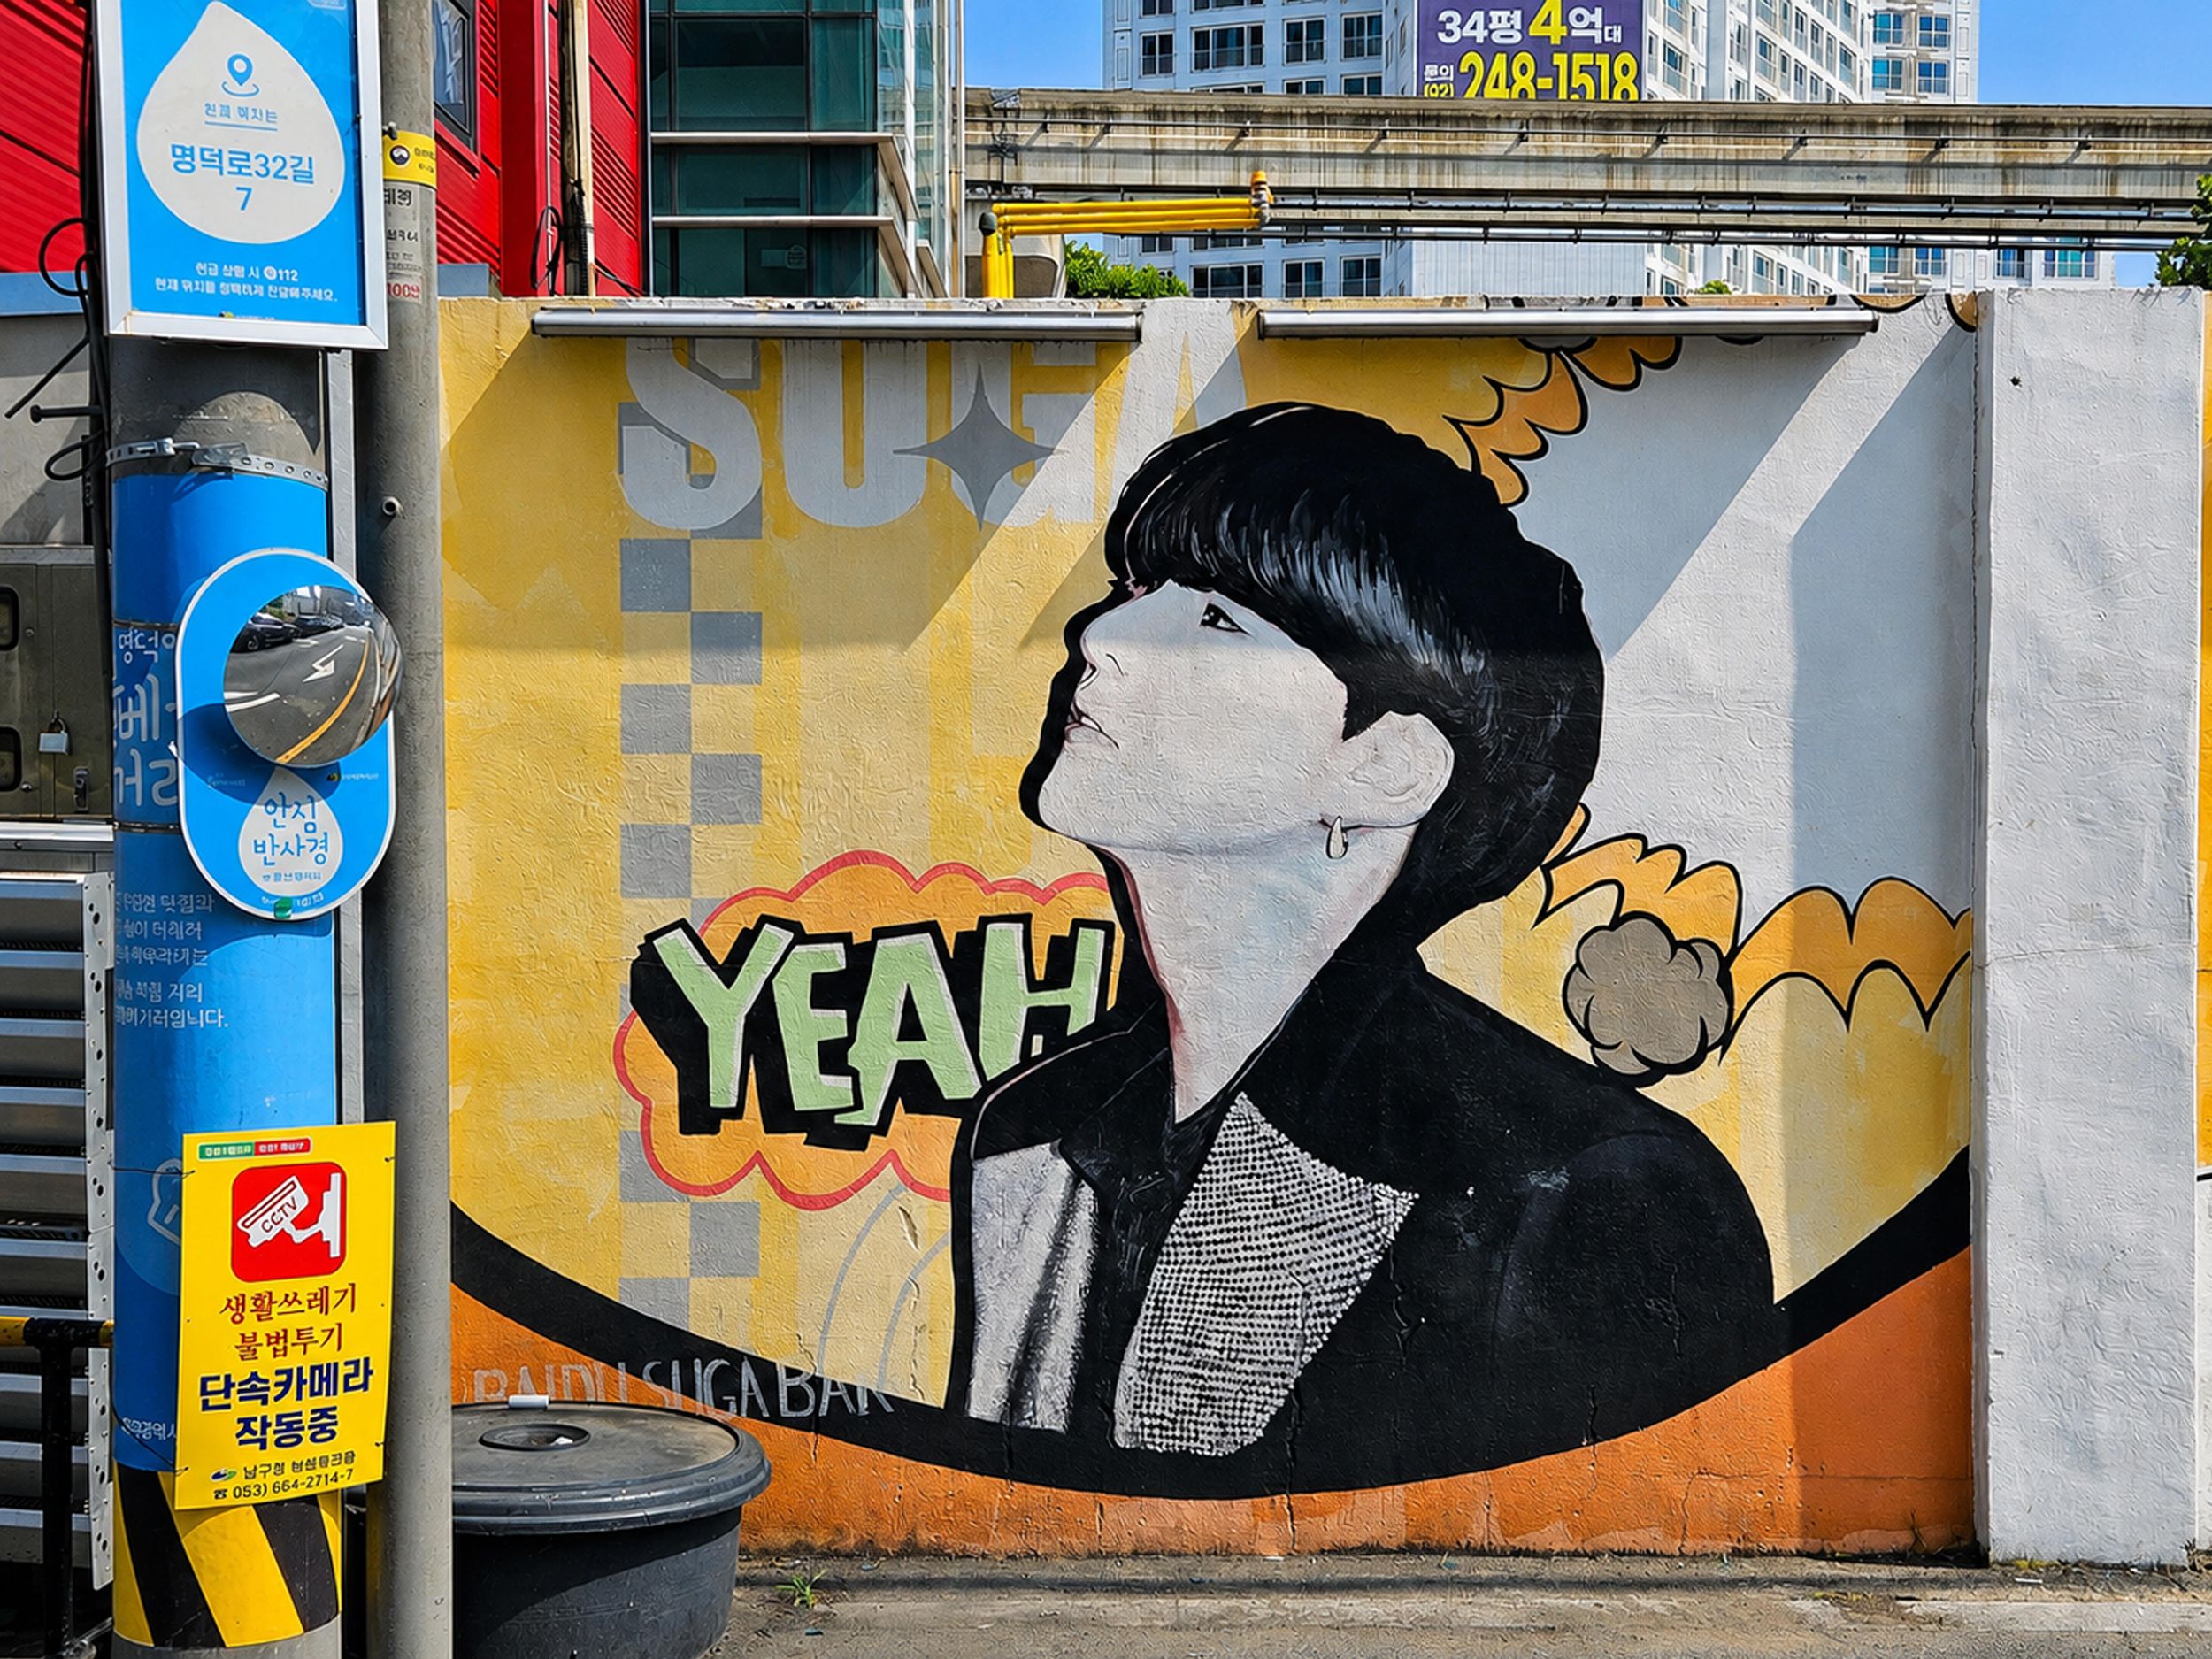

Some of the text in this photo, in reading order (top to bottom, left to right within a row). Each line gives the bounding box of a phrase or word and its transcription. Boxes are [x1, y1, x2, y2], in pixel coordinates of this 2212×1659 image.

[1437, 9, 1523, 44] 34평
[1460, 51, 1639, 100] 248-1518
[171, 143, 314, 184] 명덕로32길
[235, 186, 253, 211] 7
[278, 269, 298, 282] 112
[618, 308, 1248, 529] SUGA
[253, 832, 329, 866] 반사경
[642, 917, 1092, 1131] YEAH
[260, 1196, 297, 1233] CCTV
[219, 1282, 356, 1325] 생활쓰레기
[234, 1322, 342, 1361] 불법투기
[199, 1356, 373, 1412] 단속카메라
[235, 1406, 338, 1451] 작동중
[233, 1468, 354, 1499] 053) 664-2714-7
